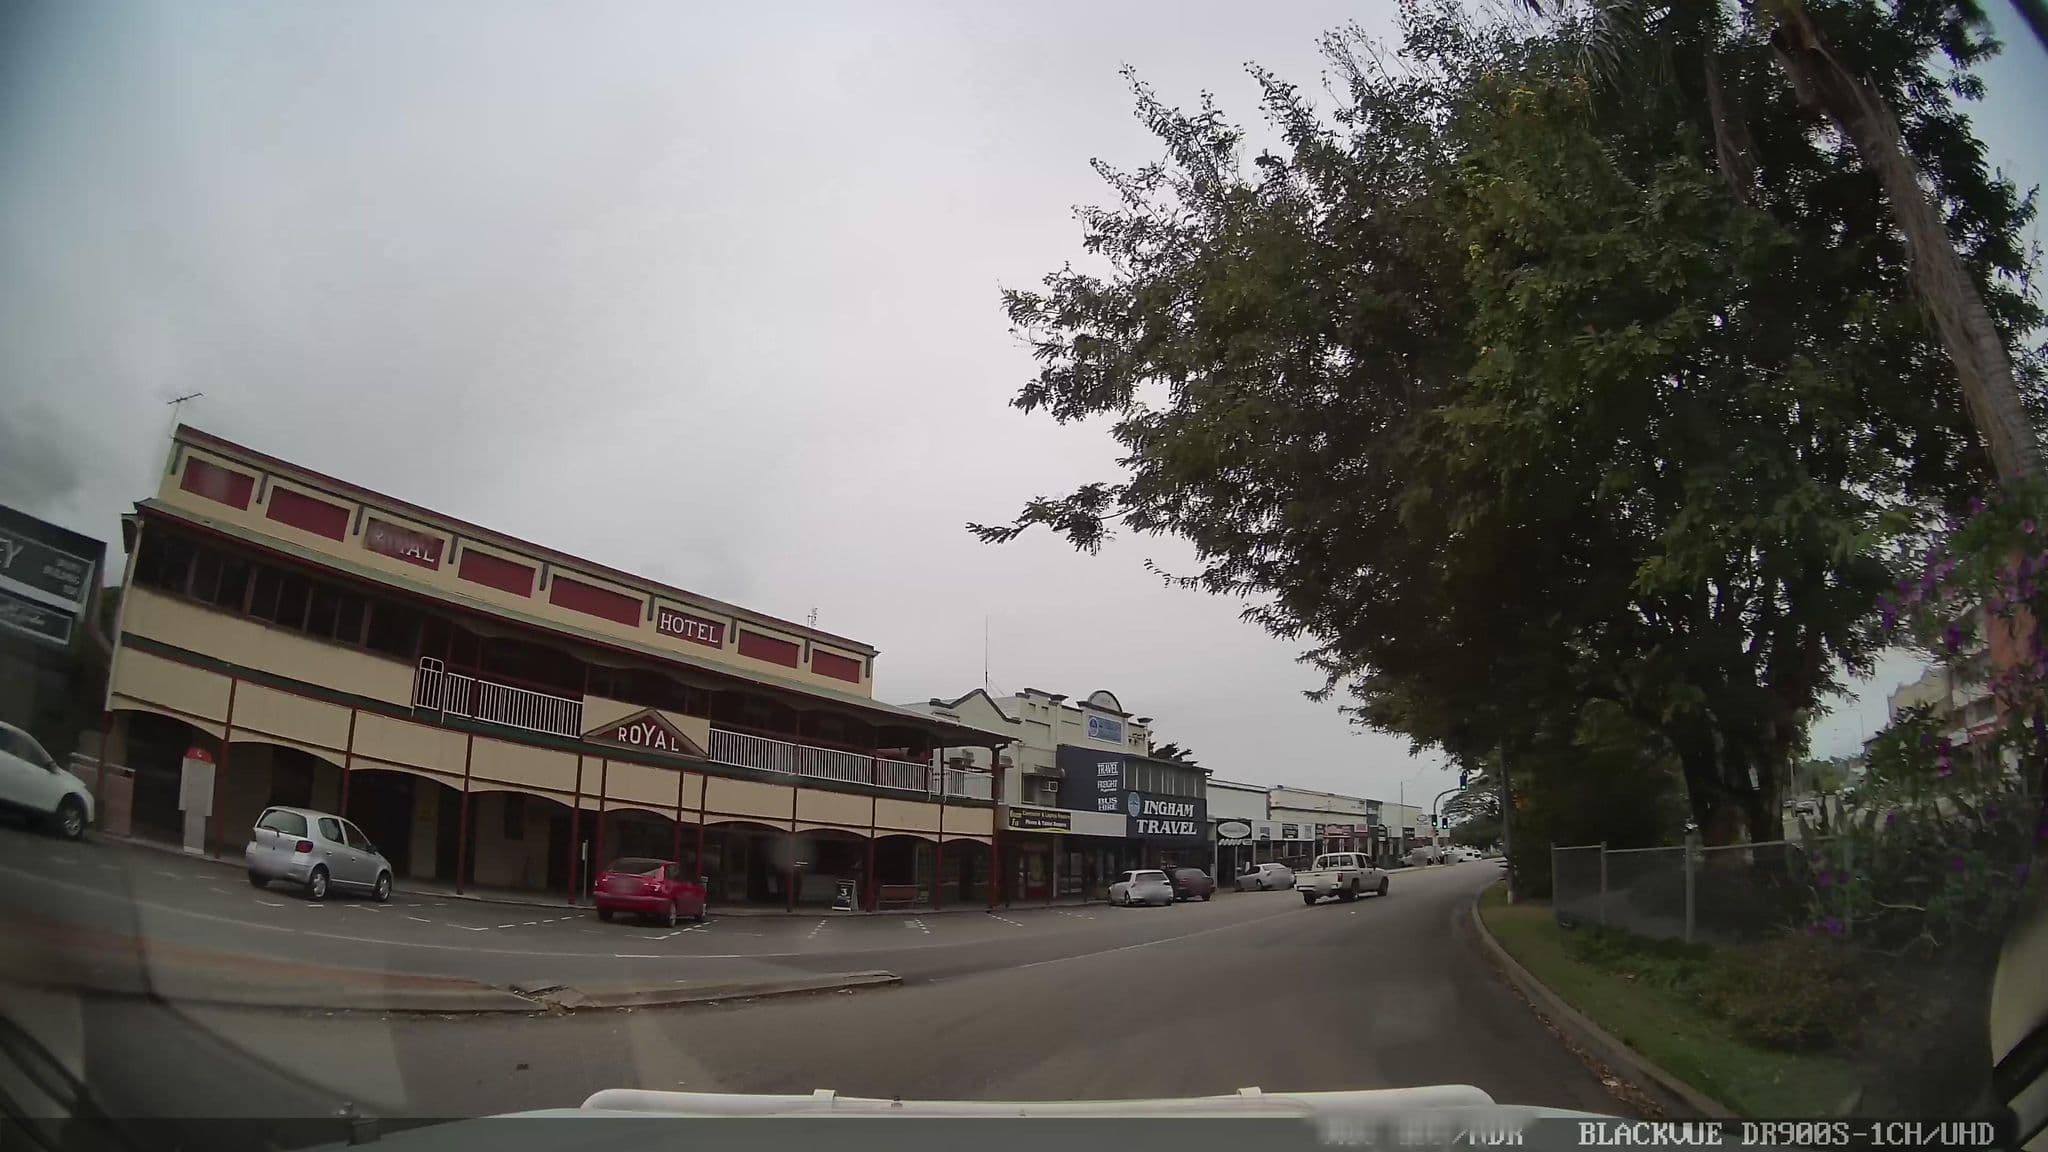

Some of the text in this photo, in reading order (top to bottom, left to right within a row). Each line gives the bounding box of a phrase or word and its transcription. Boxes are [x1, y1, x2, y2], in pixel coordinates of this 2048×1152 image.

[660, 612, 719, 643] HOTEL
[618, 722, 680, 752] ROYAL
[1143, 800, 1195, 818] INGHAM
[1136, 819, 1198, 835] TRAVEL
